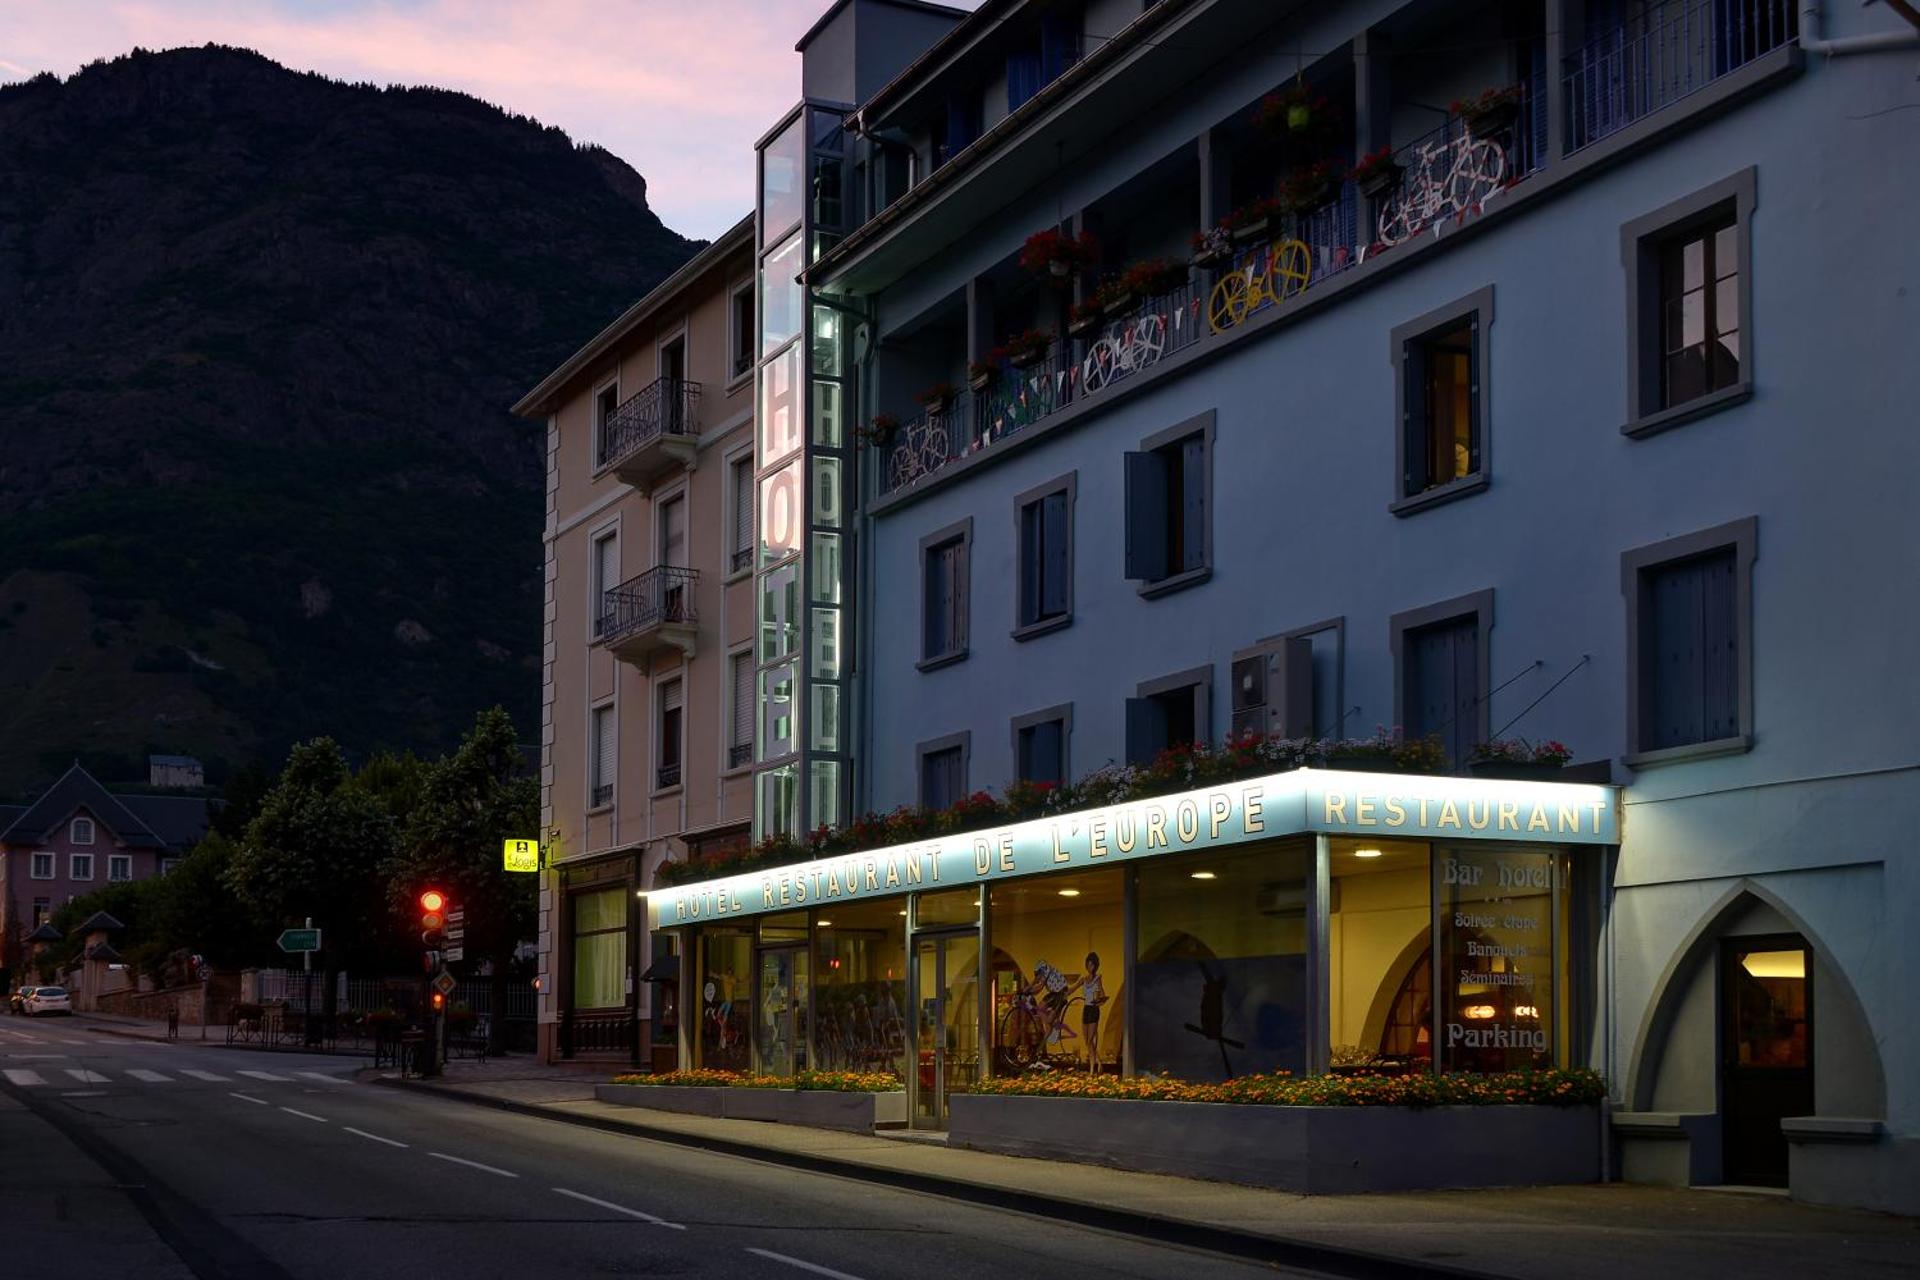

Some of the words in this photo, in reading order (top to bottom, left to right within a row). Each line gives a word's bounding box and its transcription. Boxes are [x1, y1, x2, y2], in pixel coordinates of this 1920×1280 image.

[1324, 790, 1606, 834] RESTAURANT
[763, 844, 942, 908] RESTAURANT
[973, 832, 1015, 876] DE
[1052, 785, 1264, 863] L'EUROPE
[1442, 859, 1483, 887] Bar
[1447, 1023, 1546, 1052] Parking
